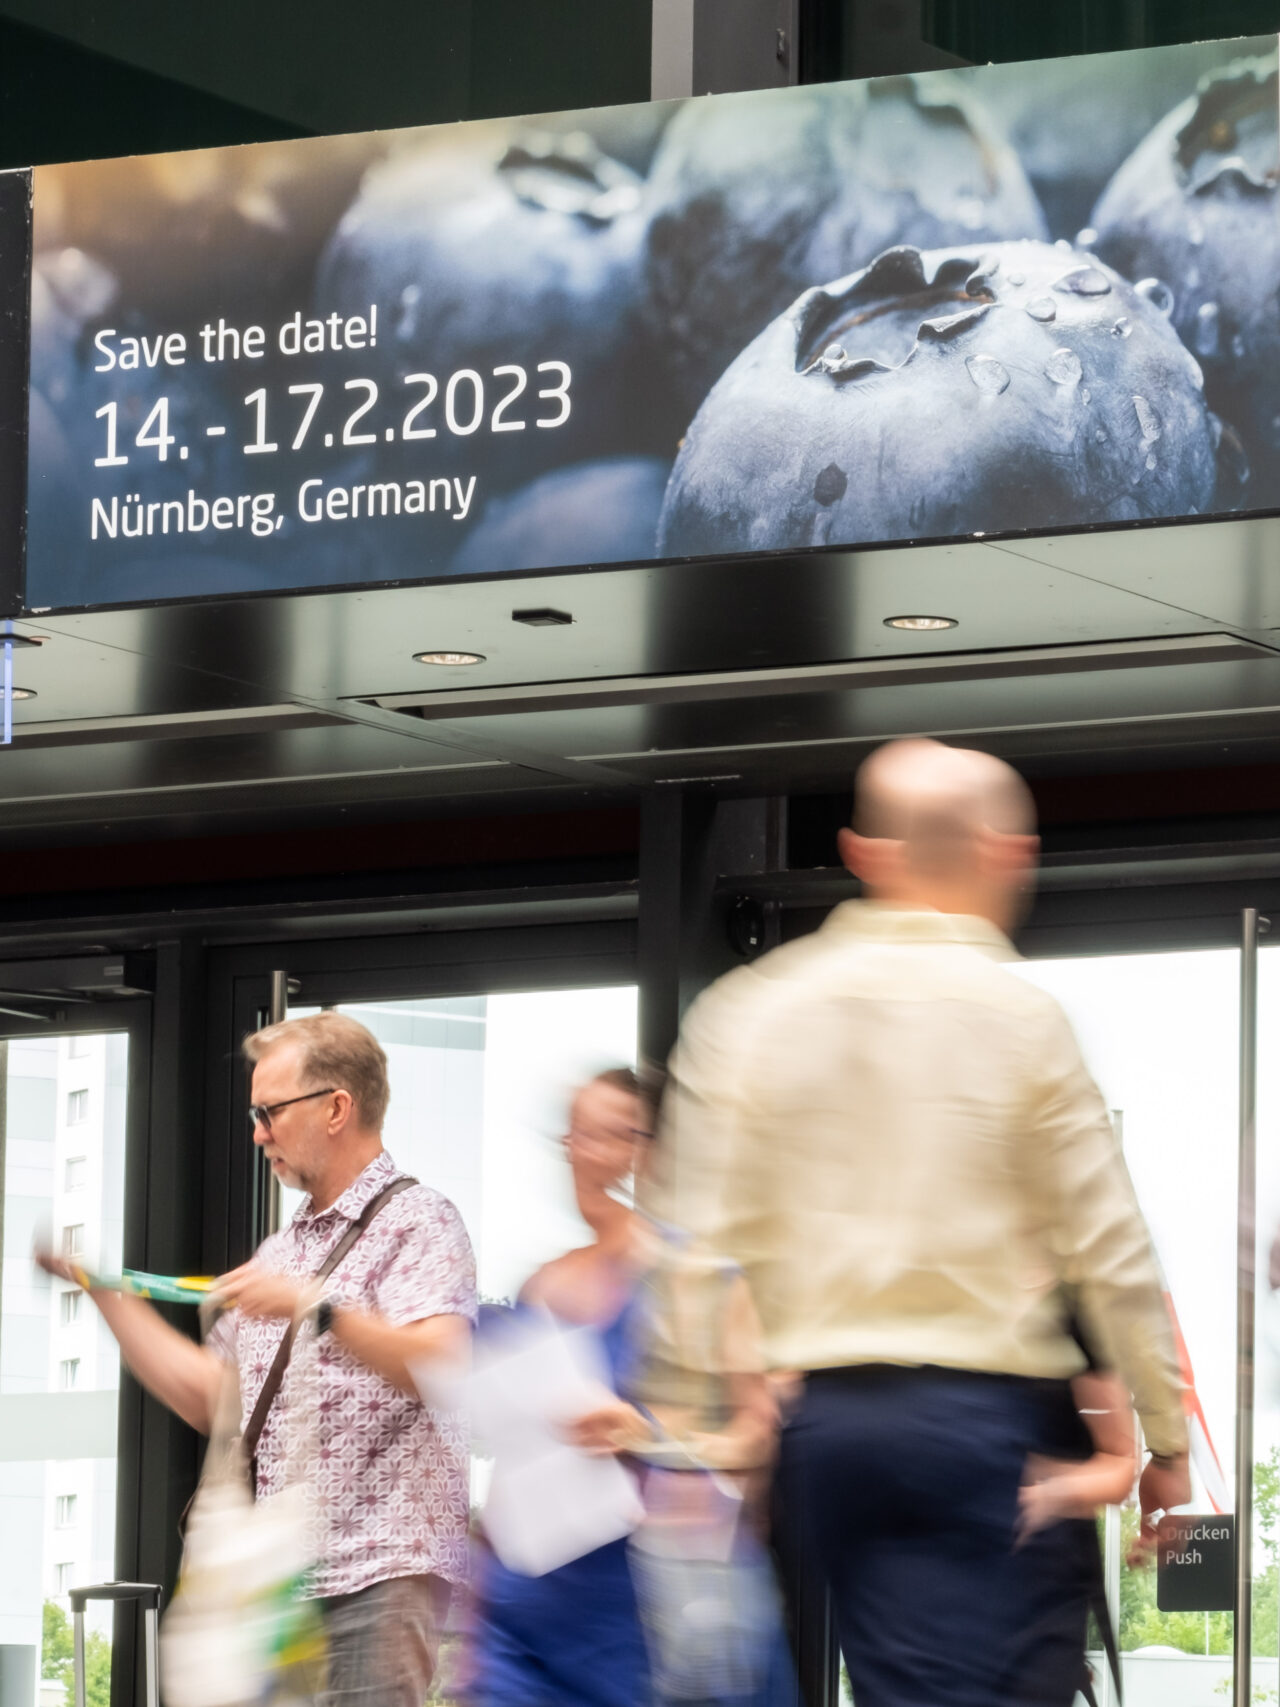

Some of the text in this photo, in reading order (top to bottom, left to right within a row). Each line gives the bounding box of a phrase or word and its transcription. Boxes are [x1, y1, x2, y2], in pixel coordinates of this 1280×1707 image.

[94, 304, 378, 372] Save the date!
[243, 361, 572, 455] 17.2.2023
[91, 475, 477, 540] Nürnberg, Germany
[1166, 1548, 1202, 1565] Push
[1167, 1524, 1230, 1541] Drücken
